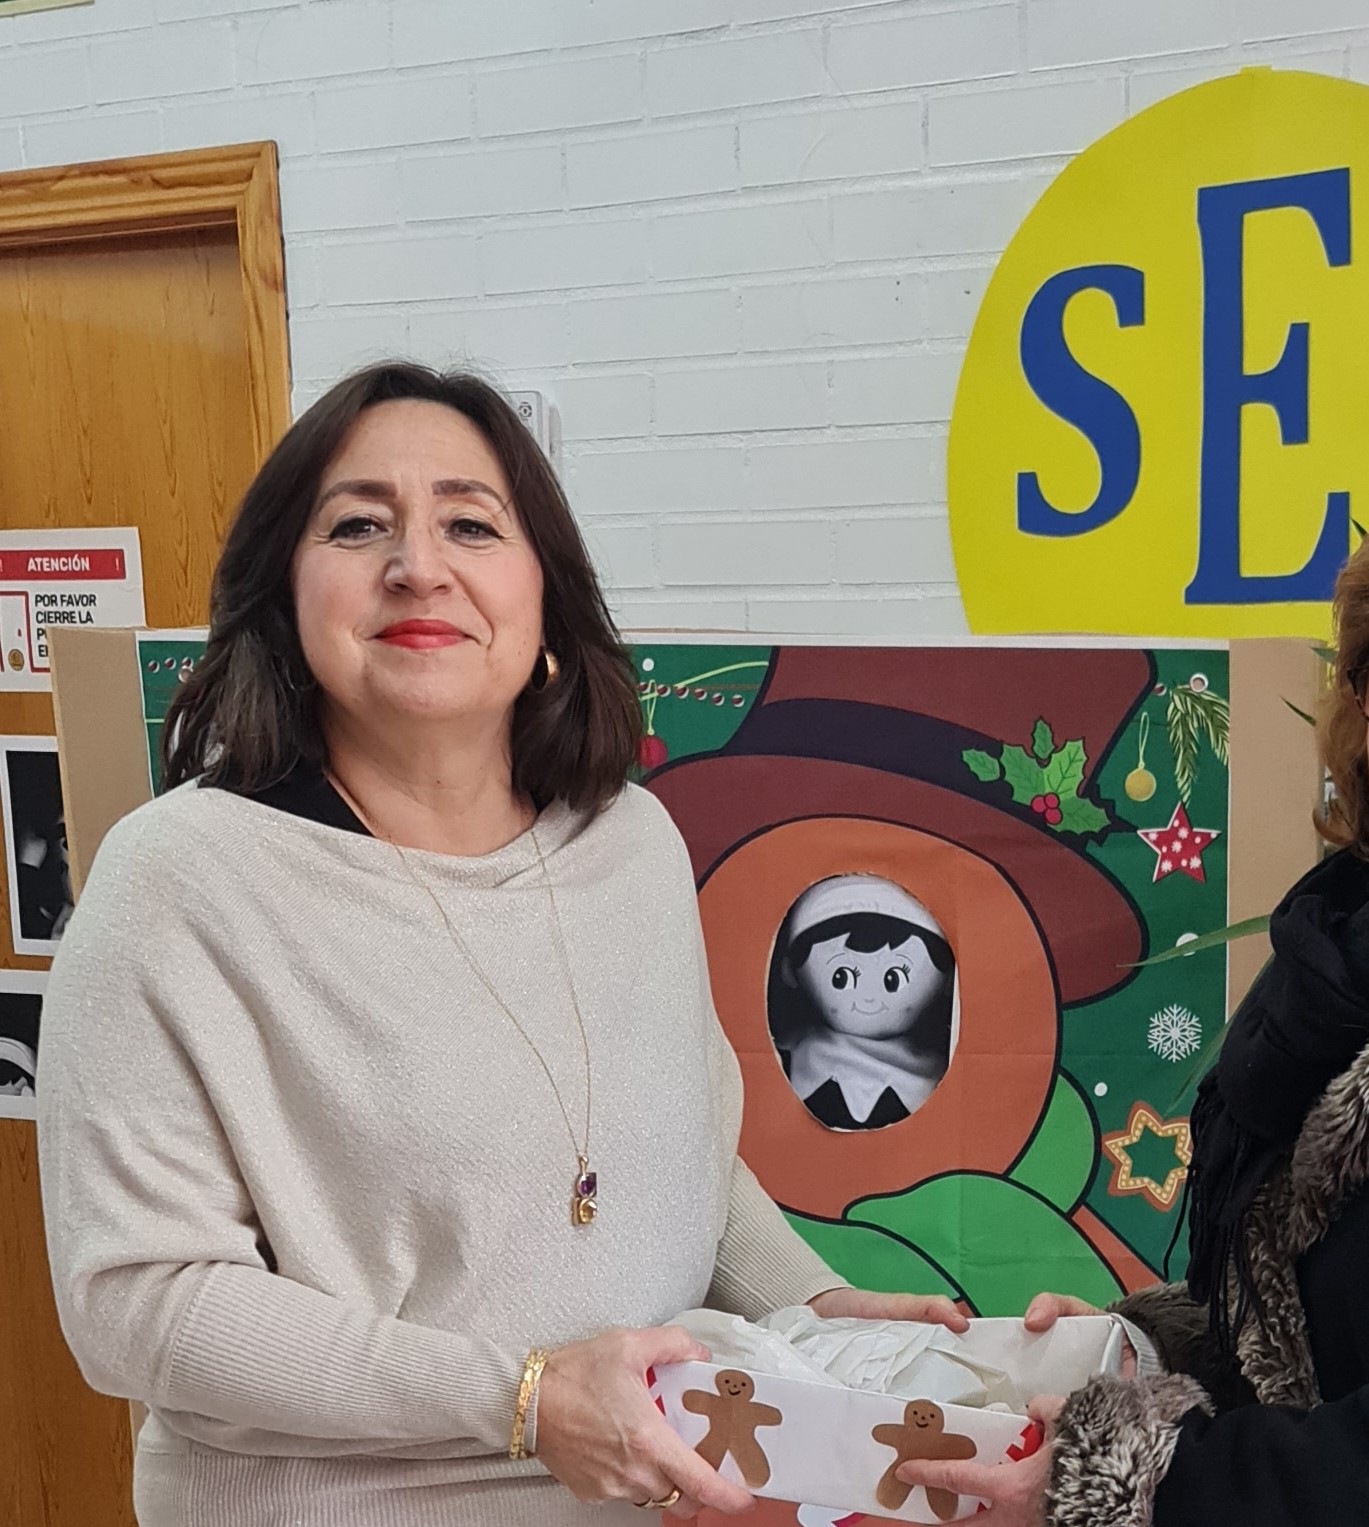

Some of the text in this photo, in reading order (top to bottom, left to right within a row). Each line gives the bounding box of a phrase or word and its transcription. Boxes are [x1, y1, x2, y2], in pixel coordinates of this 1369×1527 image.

[27, 554, 90, 572] ATENCIÓN
[35, 594, 96, 607] POR FAVOR
[36, 611, 94, 624] CIERRE LA
